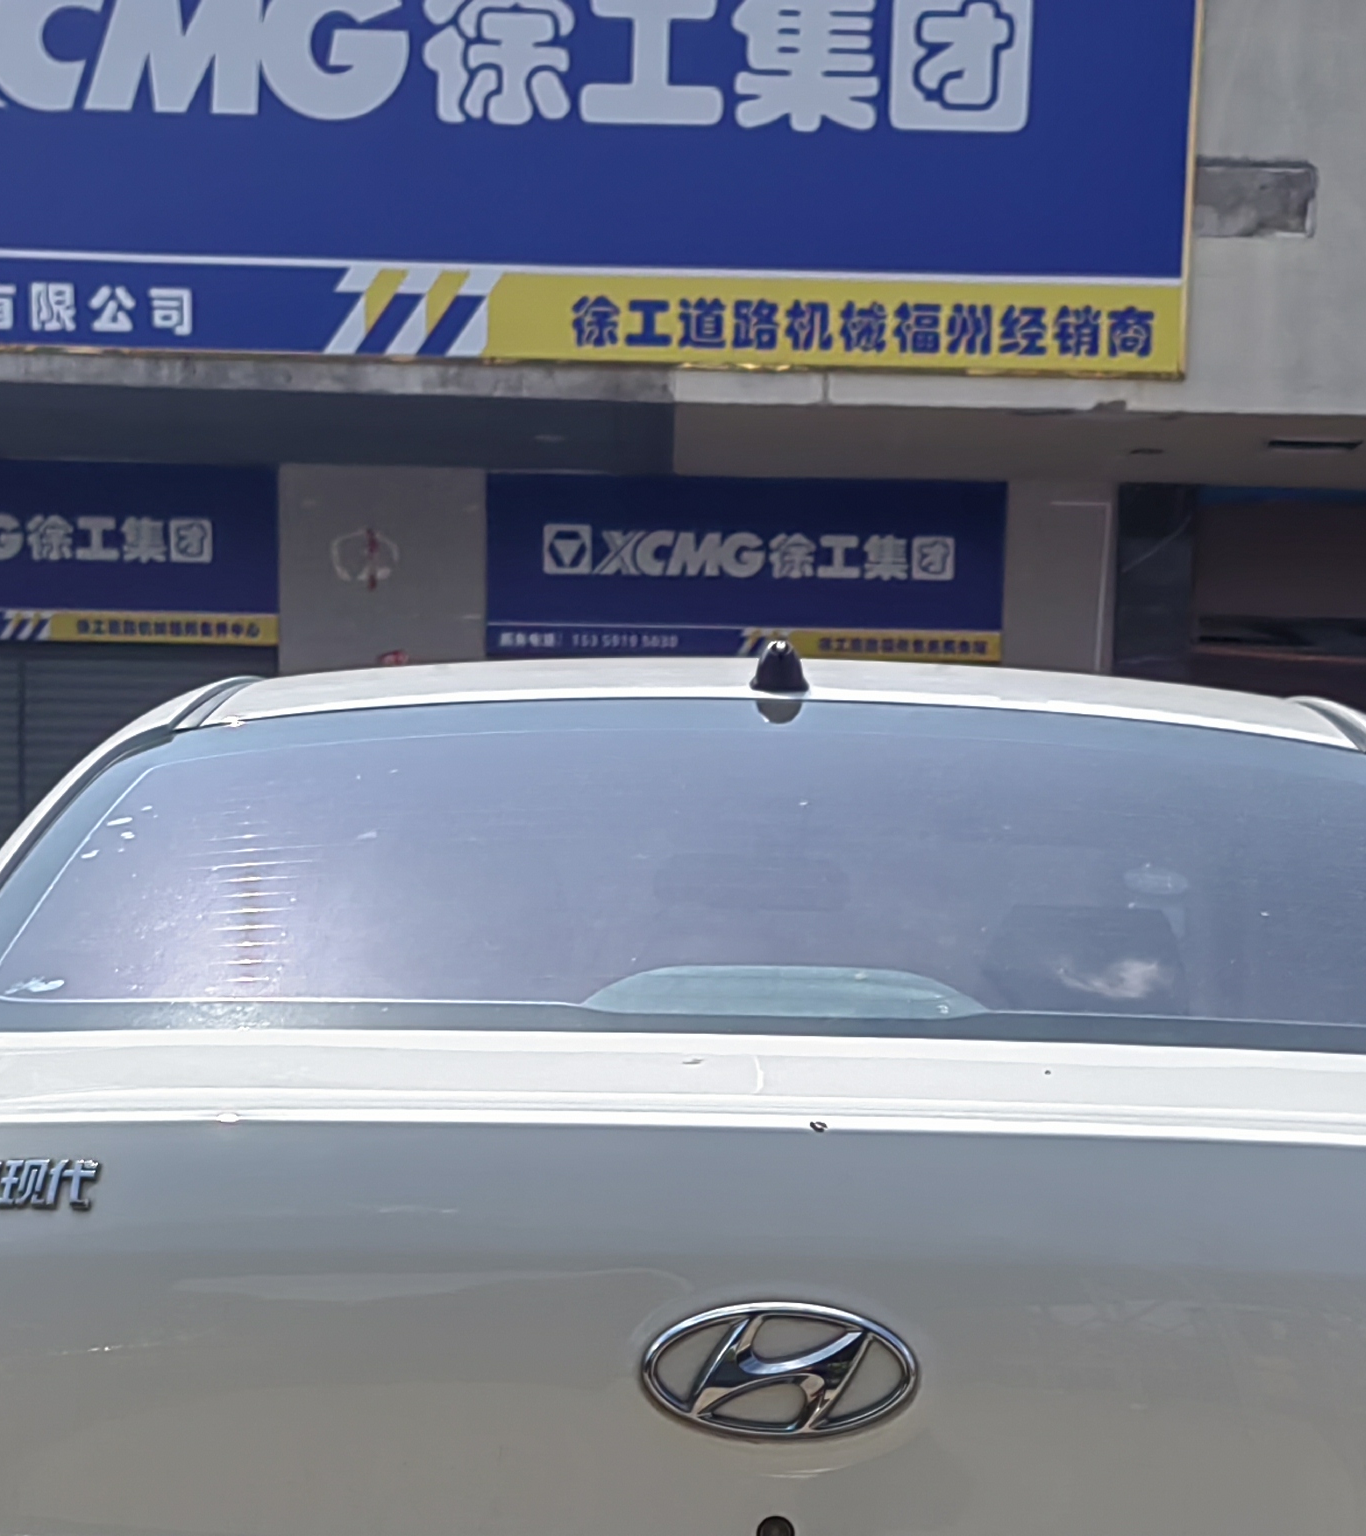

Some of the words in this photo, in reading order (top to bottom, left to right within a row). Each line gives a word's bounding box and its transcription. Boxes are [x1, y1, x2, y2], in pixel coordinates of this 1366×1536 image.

[423, 0, 1031, 133] 徐工集团
[571, 294, 1157, 359] 徐工道路机械福州经销商
[27, 514, 213, 564] 徐工集团
[592, 529, 765, 579] XCMG
[768, 533, 955, 582] 徐工集团
